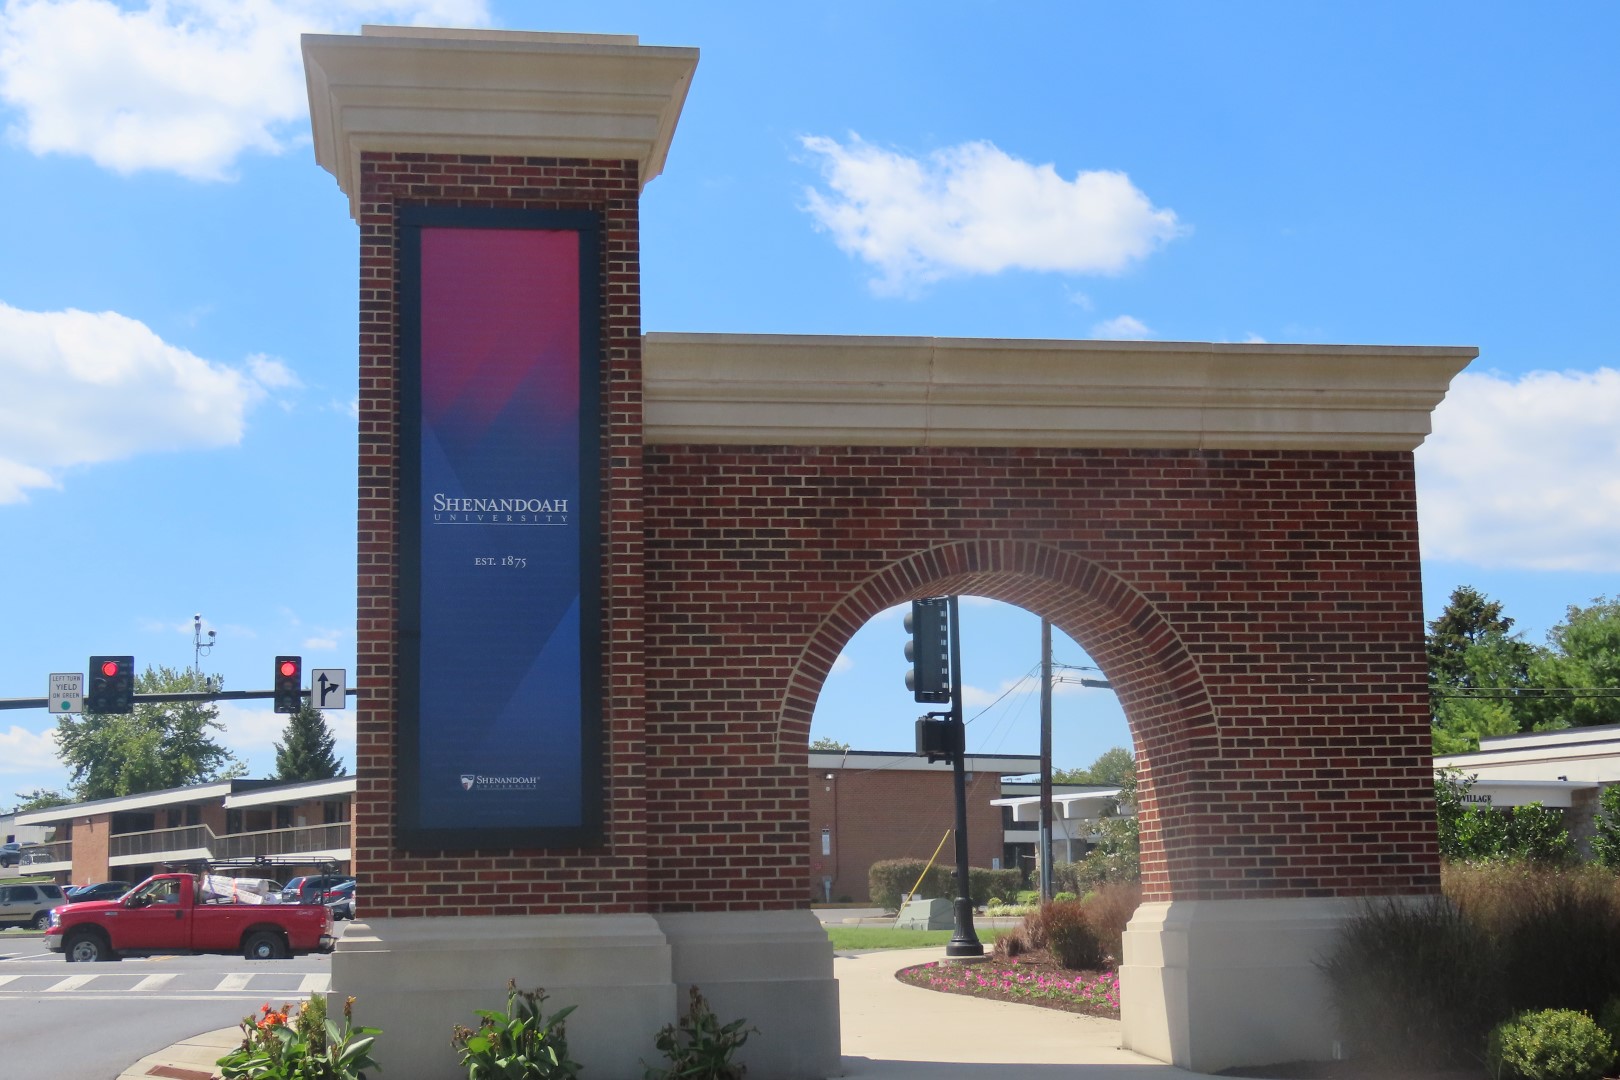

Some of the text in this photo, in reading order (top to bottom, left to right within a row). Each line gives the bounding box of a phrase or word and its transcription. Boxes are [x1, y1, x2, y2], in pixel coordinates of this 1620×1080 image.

[433, 493, 568, 512] SHENANDOAH
[434, 514, 568, 522] UNIVERSITY
[474, 555, 527, 568] EST. 1875
[56, 683, 78, 691] YIELD
[476, 775, 537, 784] SHENANDOAH
[1462, 794, 1493, 803] VILLAGE
